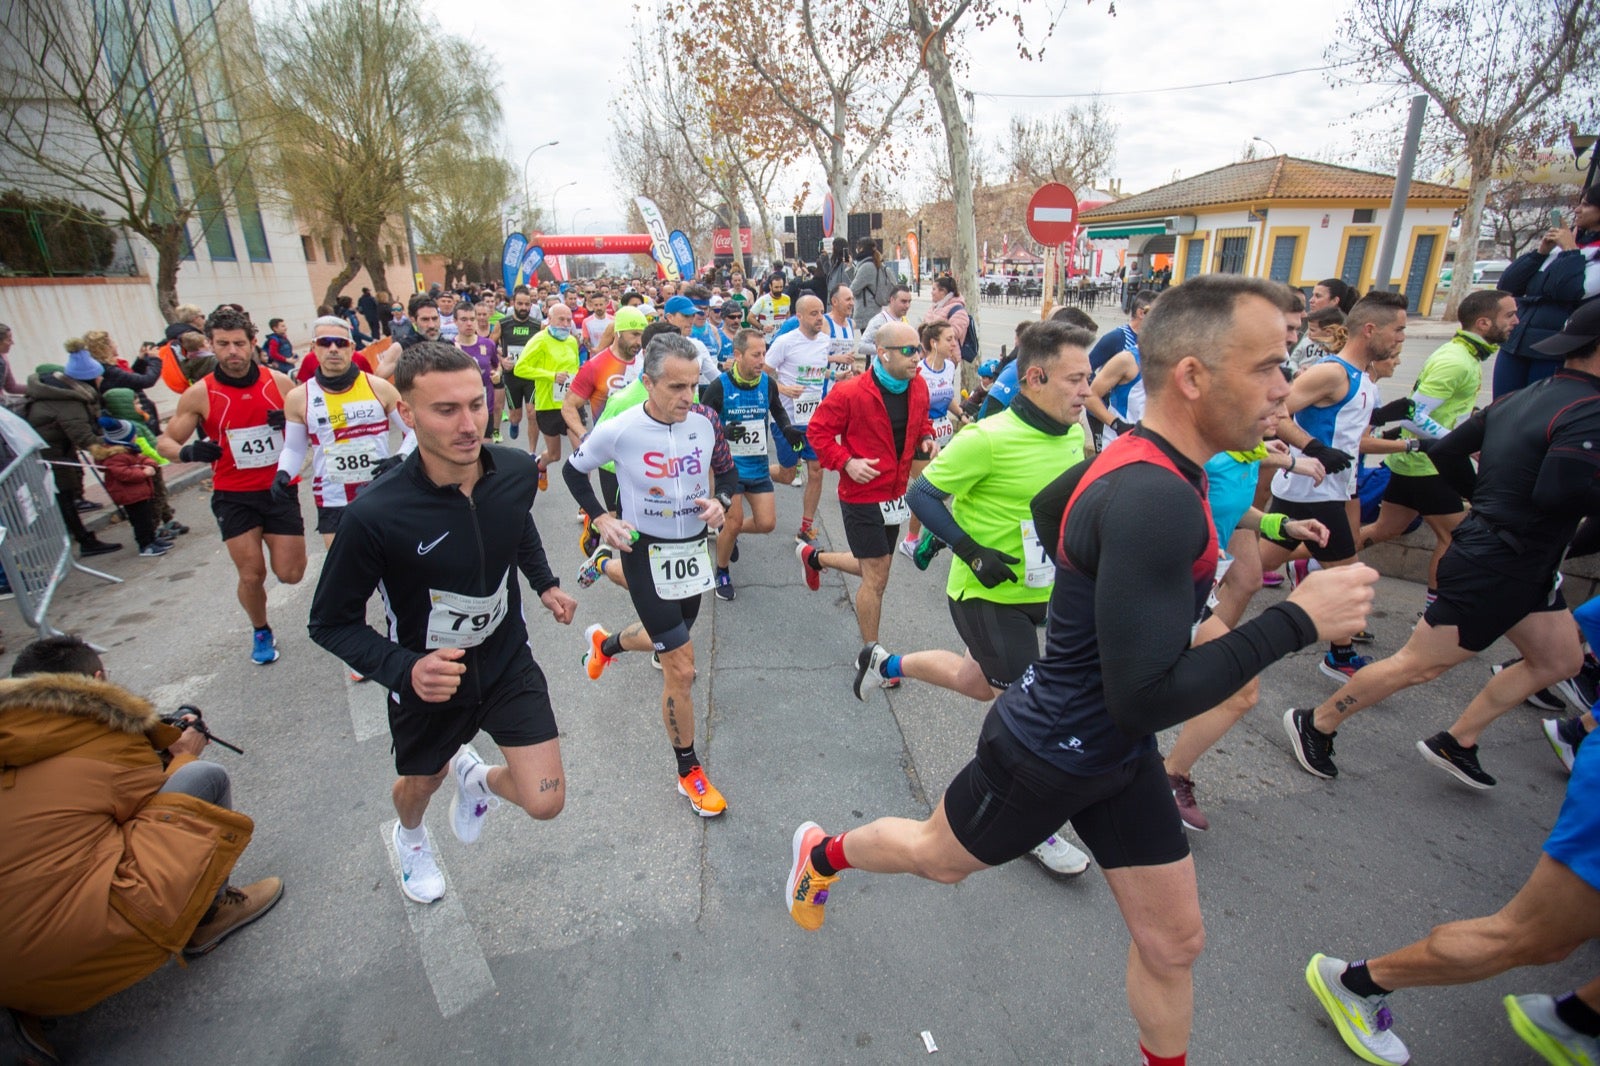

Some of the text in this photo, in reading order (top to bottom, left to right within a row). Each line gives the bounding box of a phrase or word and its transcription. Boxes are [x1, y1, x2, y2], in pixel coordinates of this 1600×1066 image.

[796, 402, 819, 414] 3077
[241, 436, 274, 455] 431
[335, 454, 370, 471] 388
[661, 556, 700, 581] 106
